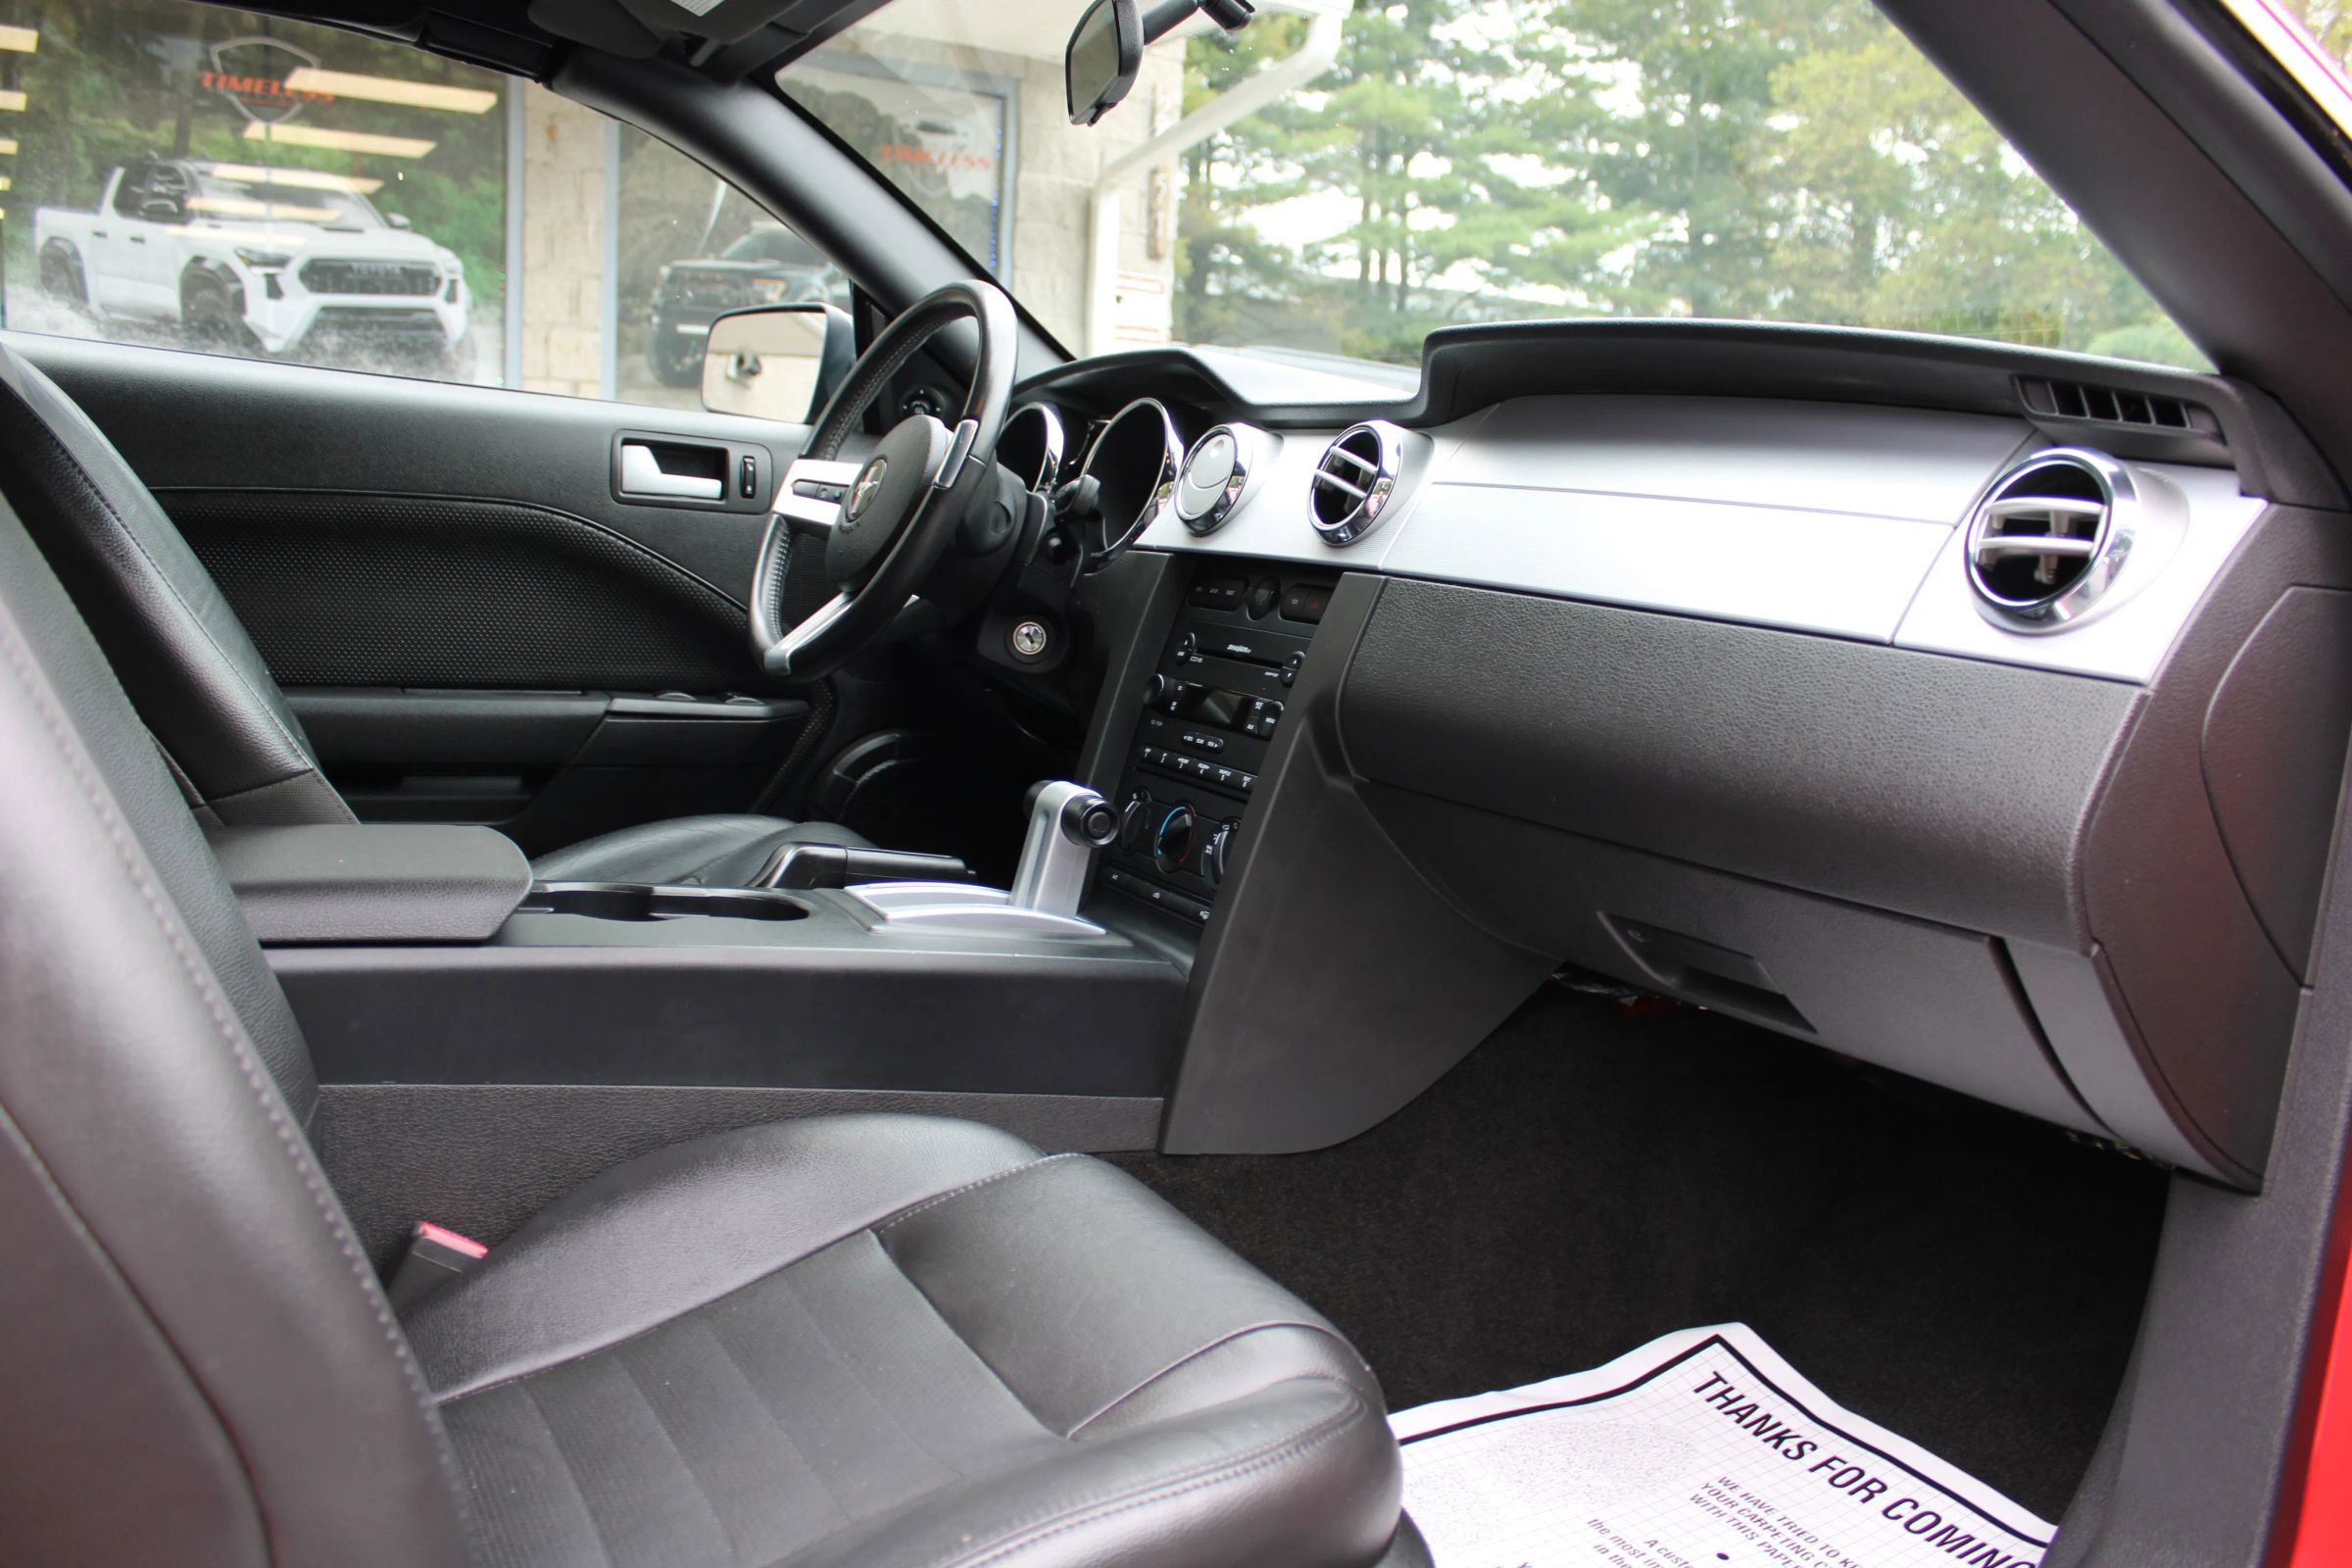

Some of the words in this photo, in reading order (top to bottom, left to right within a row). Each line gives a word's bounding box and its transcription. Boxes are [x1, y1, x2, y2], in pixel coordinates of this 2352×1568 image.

[1693, 1370, 1818, 1461] THANKS
[1808, 1455, 1888, 1504] FOR
[1587, 1518, 1611, 1535] the
[1609, 1536, 1647, 1559] most
[1690, 1494, 1728, 1518] WITH
[1726, 1517, 1760, 1541] THIS
[1700, 1482, 1740, 1509] YOUR
[1737, 1507, 1815, 1561] CARPETING
[1718, 1476, 1741, 1493] WE
[1739, 1492, 1779, 1515] HAVE
[1777, 1515, 1820, 1544] TRIED
[1819, 1544, 1841, 1558] TO
[1592, 1543, 1610, 1554] in
[1642, 1539, 1659, 1548] A
